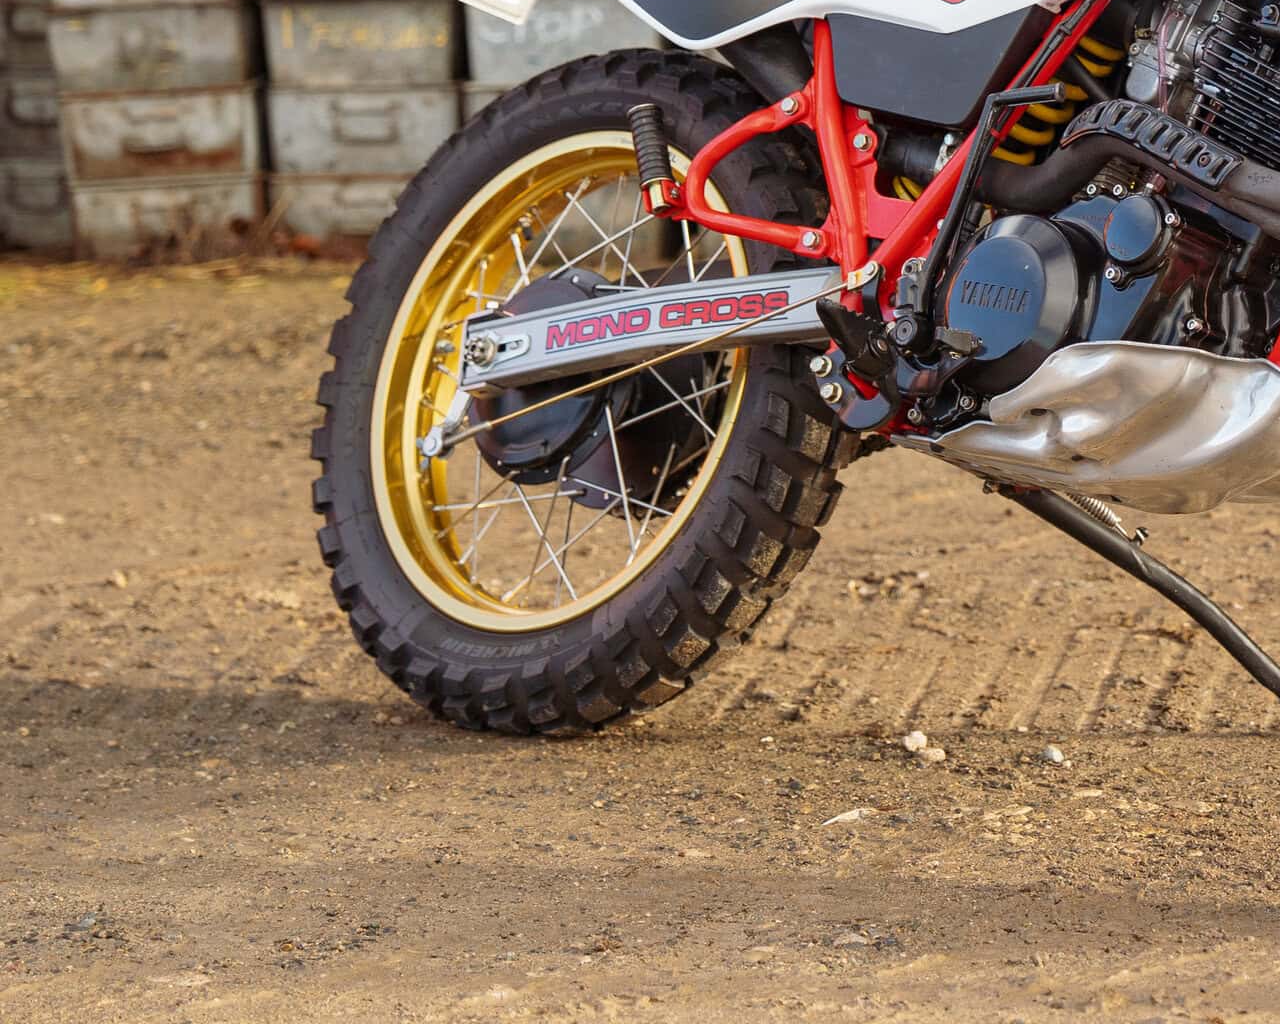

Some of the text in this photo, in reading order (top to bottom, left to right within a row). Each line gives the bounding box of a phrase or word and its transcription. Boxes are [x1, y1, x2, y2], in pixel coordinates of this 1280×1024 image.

[961, 280, 1032, 313] YAMAHA
[545, 290, 790, 351] MONO CROSS
